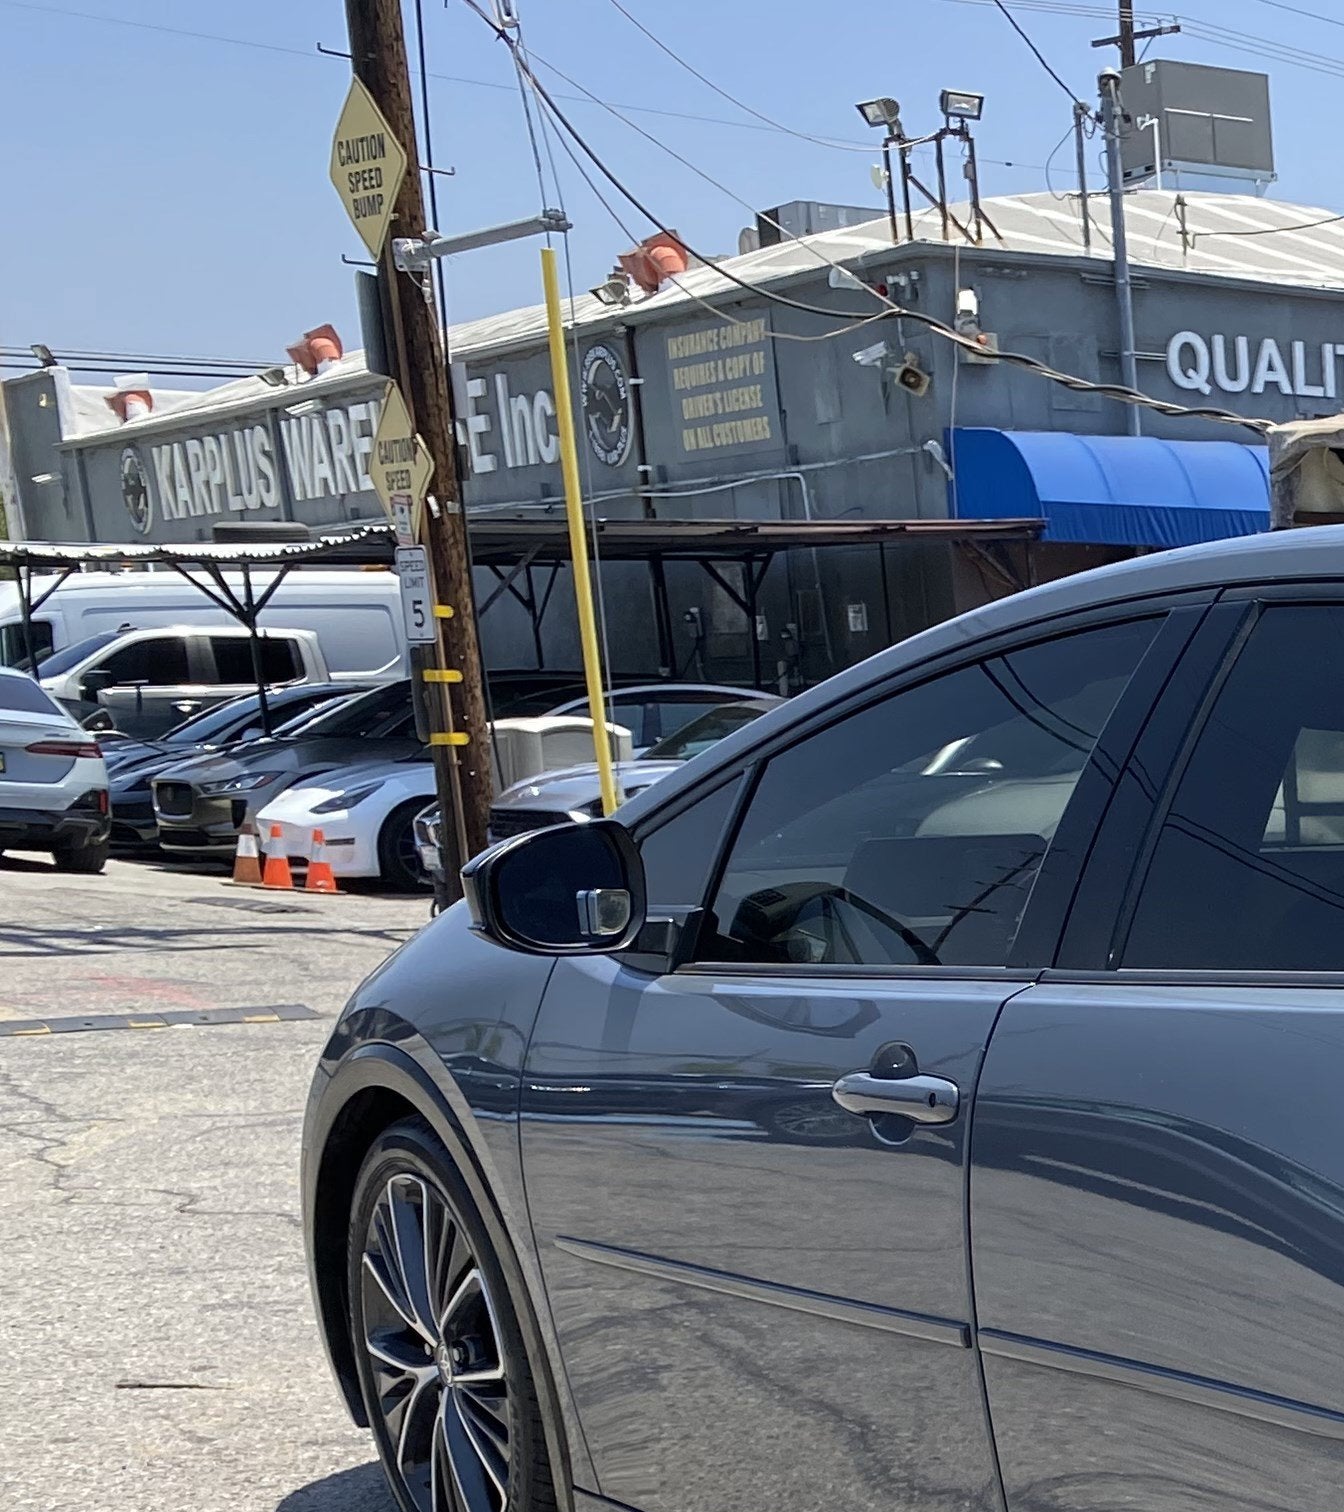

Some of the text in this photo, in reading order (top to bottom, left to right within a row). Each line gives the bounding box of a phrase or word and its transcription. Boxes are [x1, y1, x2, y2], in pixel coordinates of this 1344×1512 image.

[337, 133, 386, 167] CAUTION
[347, 167, 382, 194] SPEED
[353, 194, 384, 219] BUMP
[668, 318, 765, 360] INSURANCE COMPANY
[673, 351, 765, 390] REQUIRES A COPY OF
[682, 384, 763, 420] DRIVER'S LICENSE
[683, 416, 771, 451] ON ALL CUSTOMERS
[152, 425, 280, 521] KARPLUS
[280, 378, 497, 501] WAREE
[378, 437, 415, 466] CAUTION
[385, 470, 411, 491] SPEED
[400, 560, 425, 572] SPEED
[404, 577, 424, 589] LIMIT
[412, 600, 426, 628] 5
